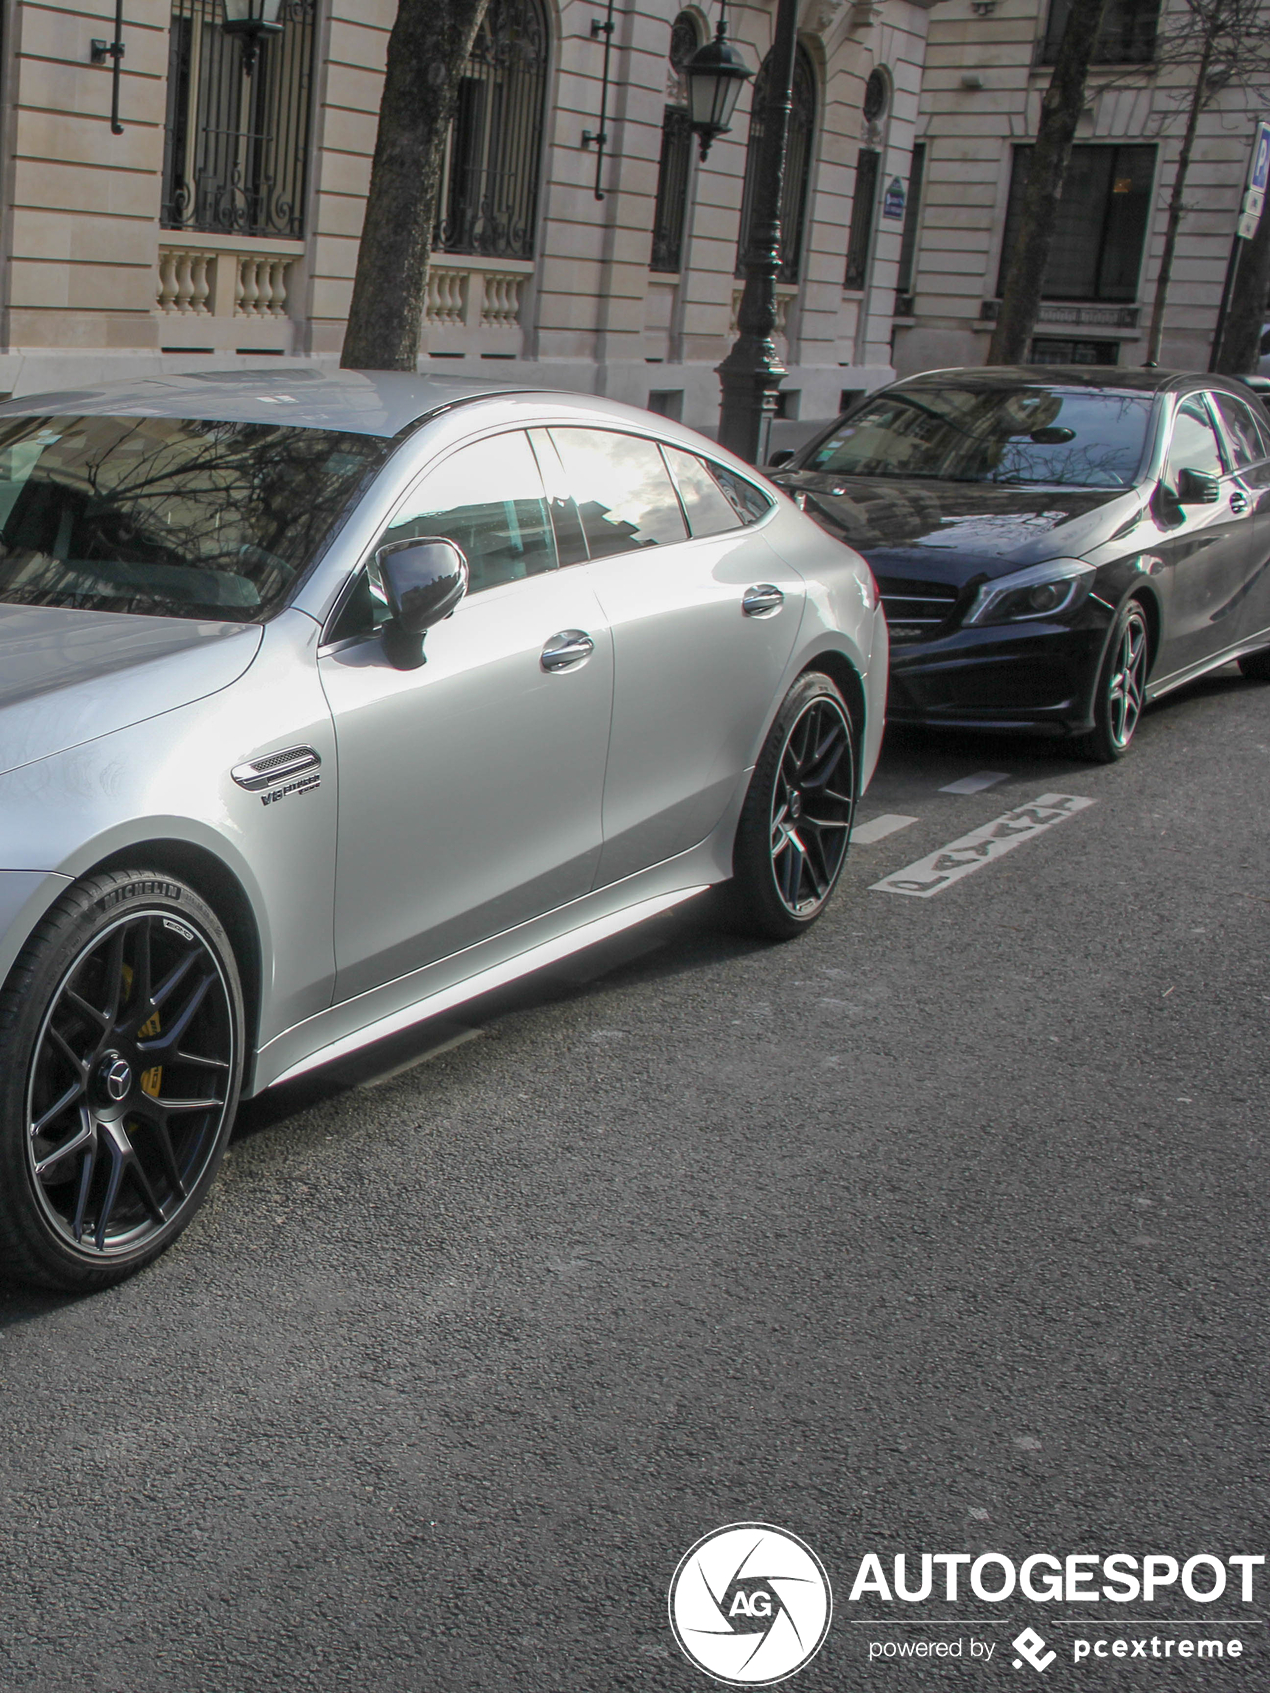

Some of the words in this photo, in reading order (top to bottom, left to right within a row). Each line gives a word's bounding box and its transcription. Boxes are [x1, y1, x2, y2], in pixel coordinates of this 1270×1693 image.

[260, 789, 283, 807] V8
[886, 797, 1076, 891] PAYANT
[104, 881, 178, 910] MICHELIN
